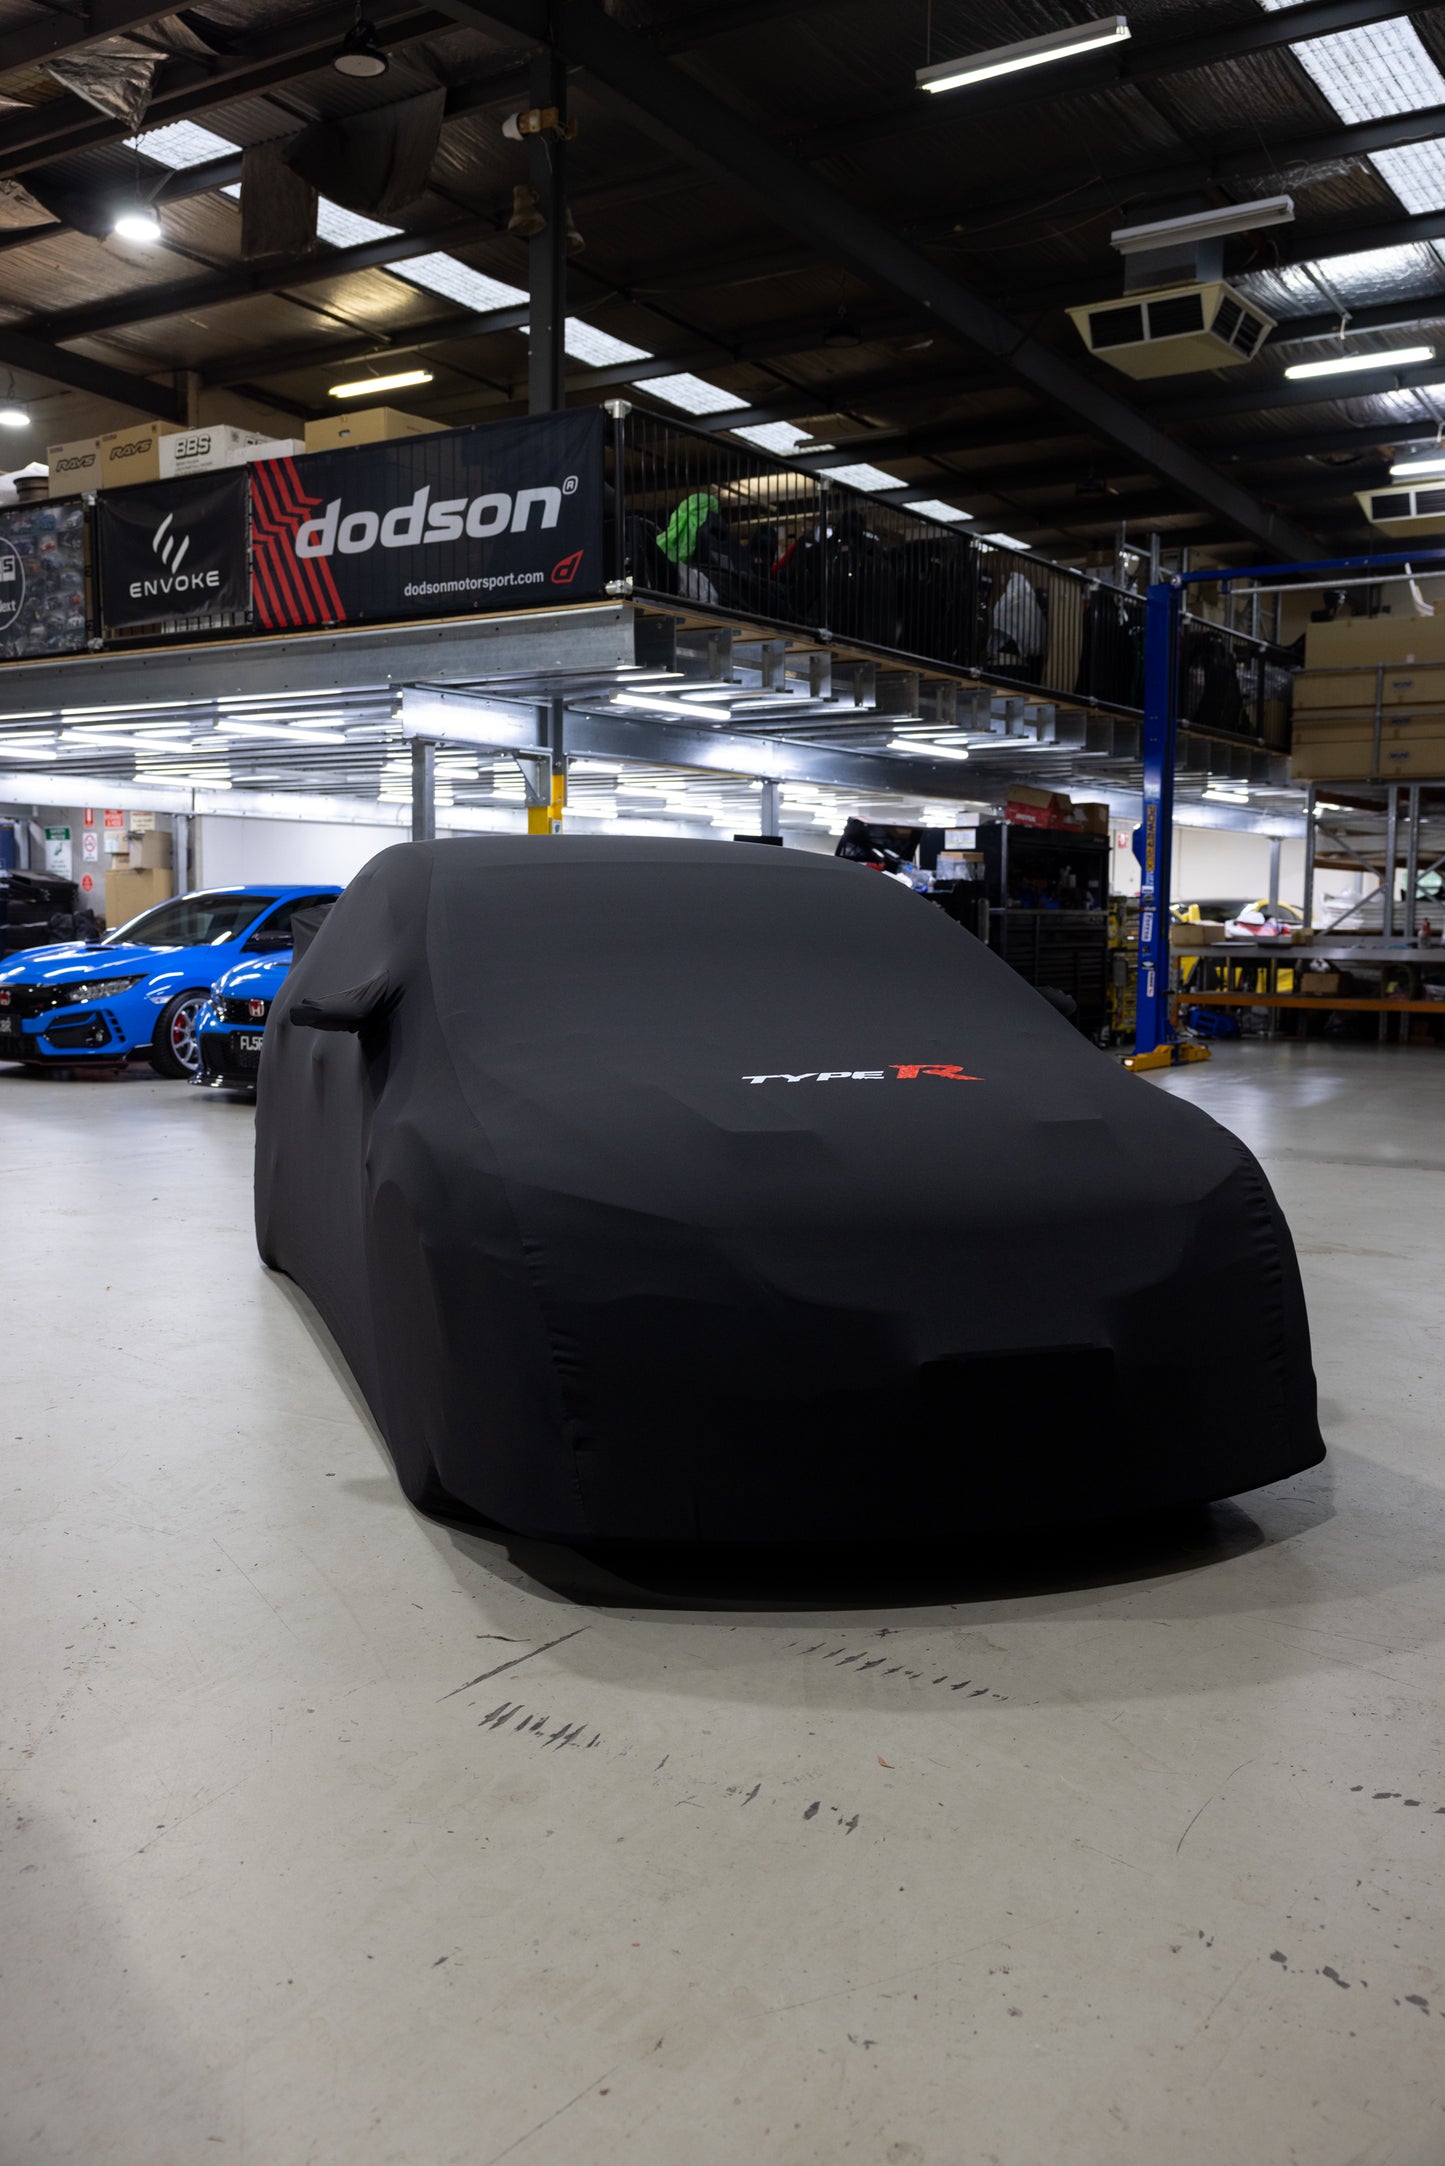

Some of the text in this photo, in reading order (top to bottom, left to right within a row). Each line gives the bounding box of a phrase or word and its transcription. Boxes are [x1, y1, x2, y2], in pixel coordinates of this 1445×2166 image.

[109, 439, 152, 461] RAYS
[174, 434, 211, 460] BBS
[56, 454, 96, 473] RAYS
[129, 570, 220, 598] ENVOKE
[404, 571, 545, 597] dodsonmotorsport.com
[741, 1064, 986, 1085] TYPE R
